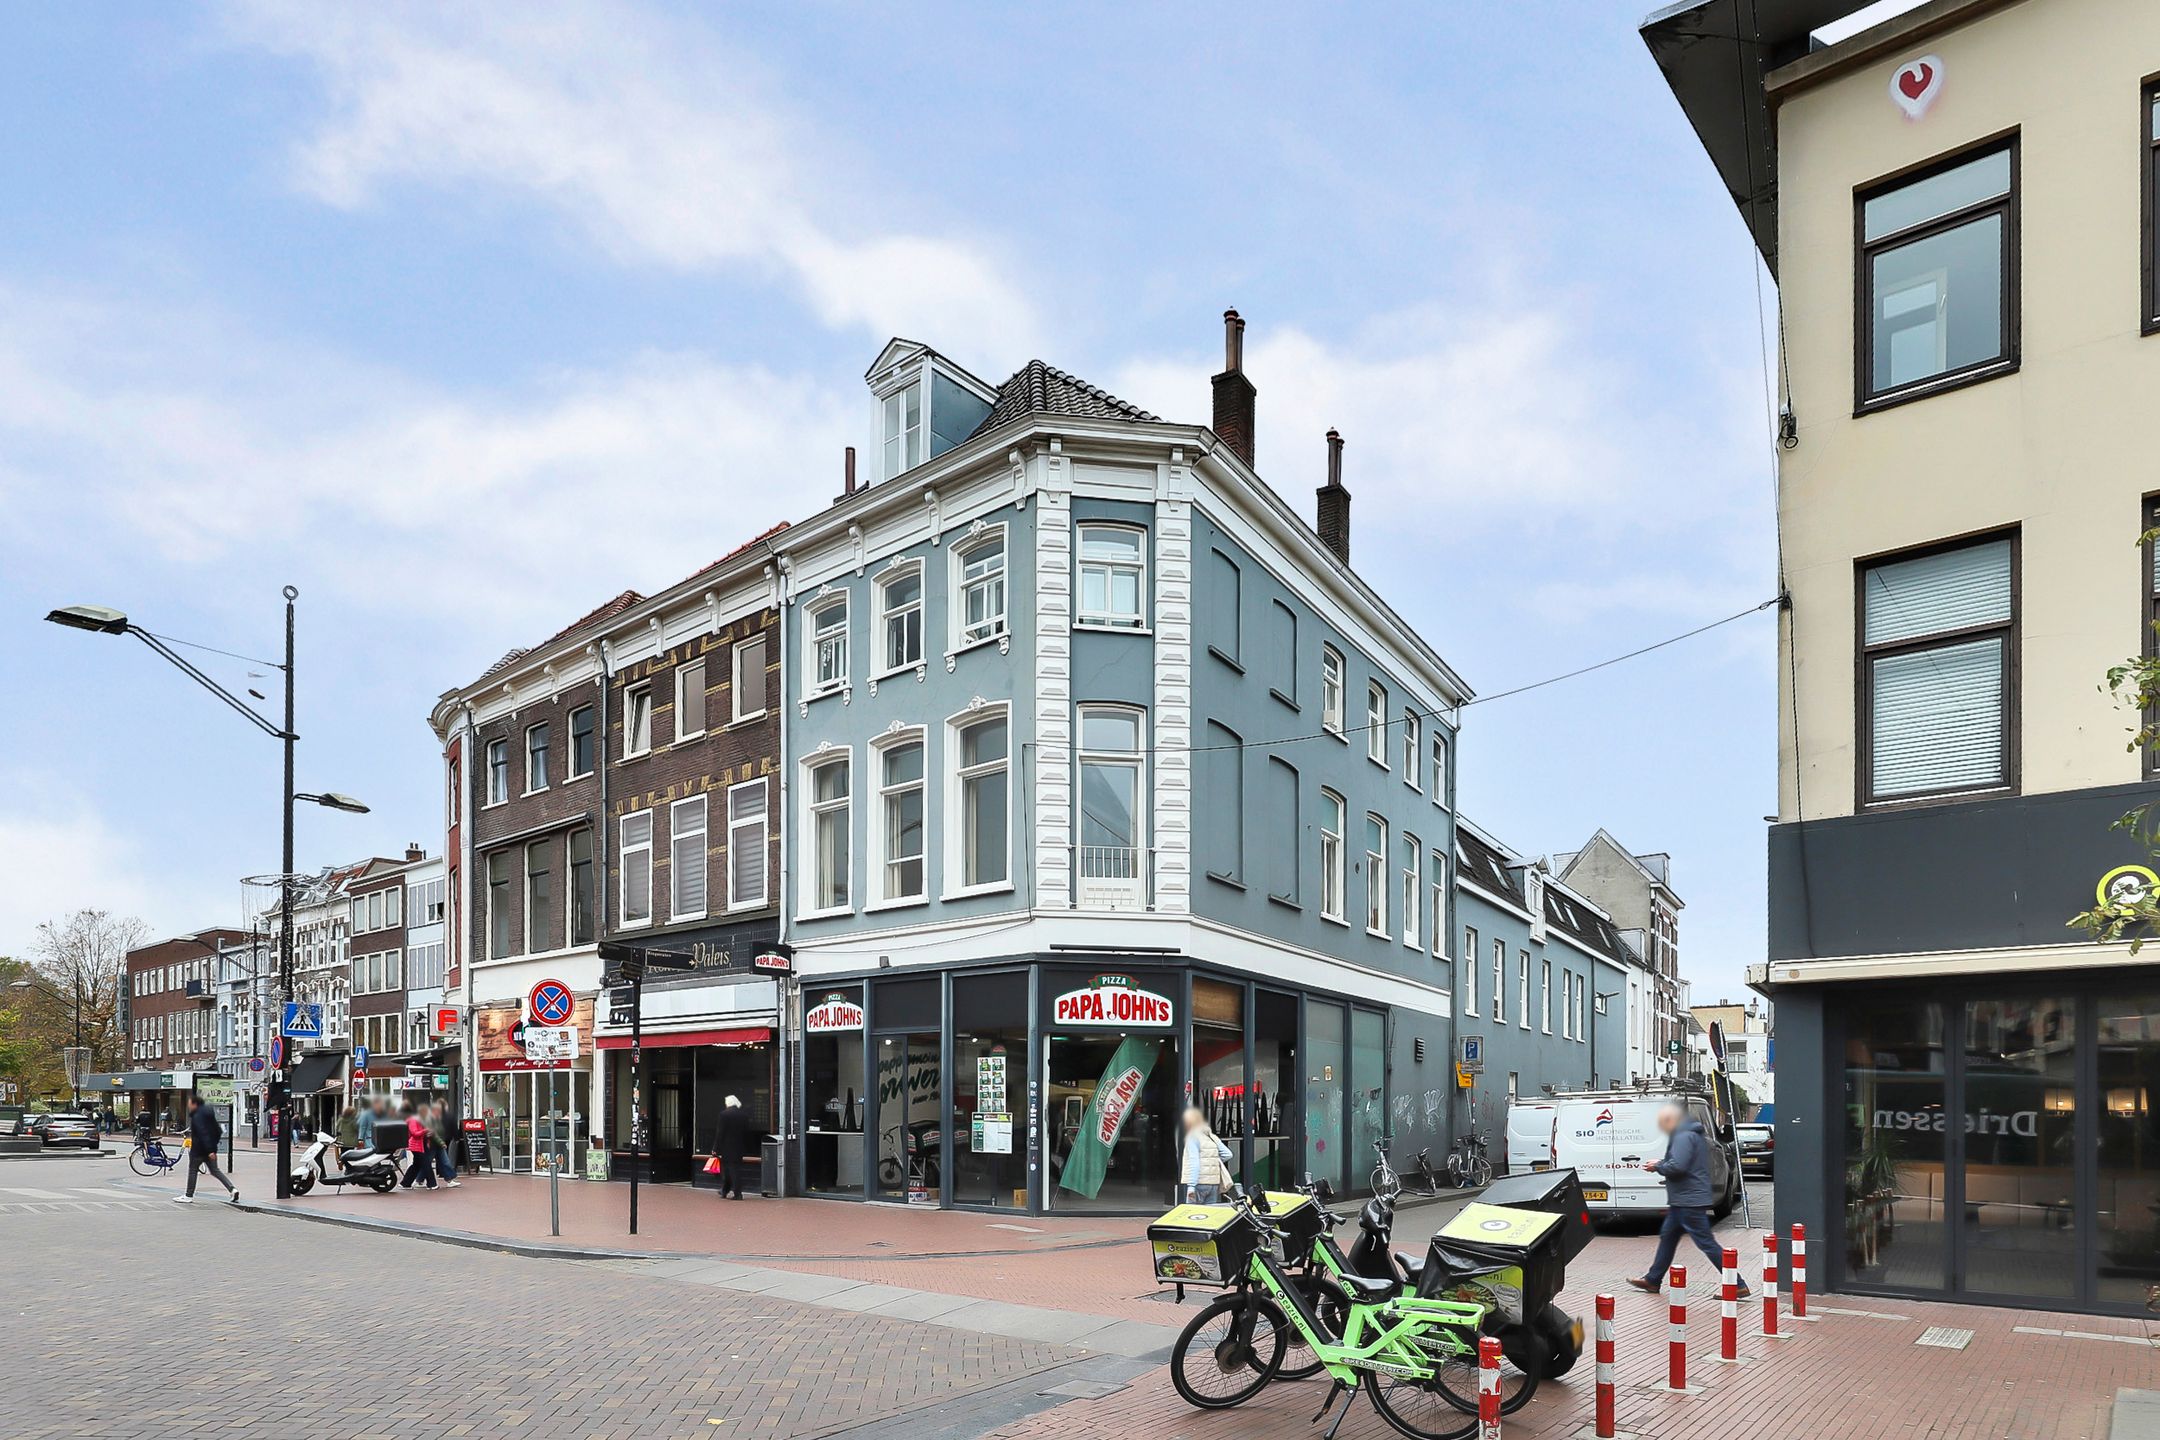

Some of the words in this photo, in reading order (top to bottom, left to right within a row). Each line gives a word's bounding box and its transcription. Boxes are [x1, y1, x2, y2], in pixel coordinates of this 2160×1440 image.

[756, 956, 770, 966] PAPA
[770, 957, 789, 968] JOHN'S
[1101, 976, 1127, 985] PIZZA
[828, 993, 841, 1001] PIZZA
[1058, 993, 1104, 1020] PAPA
[1106, 992, 1169, 1022] JOHN'S
[437, 1009, 459, 1032] F
[808, 1008, 830, 1028] PAPA
[830, 1006, 862, 1027] JOHN'S
[1468, 1042, 1475, 1052] P
[1282, 1299, 1307, 1331] eazie.nl
